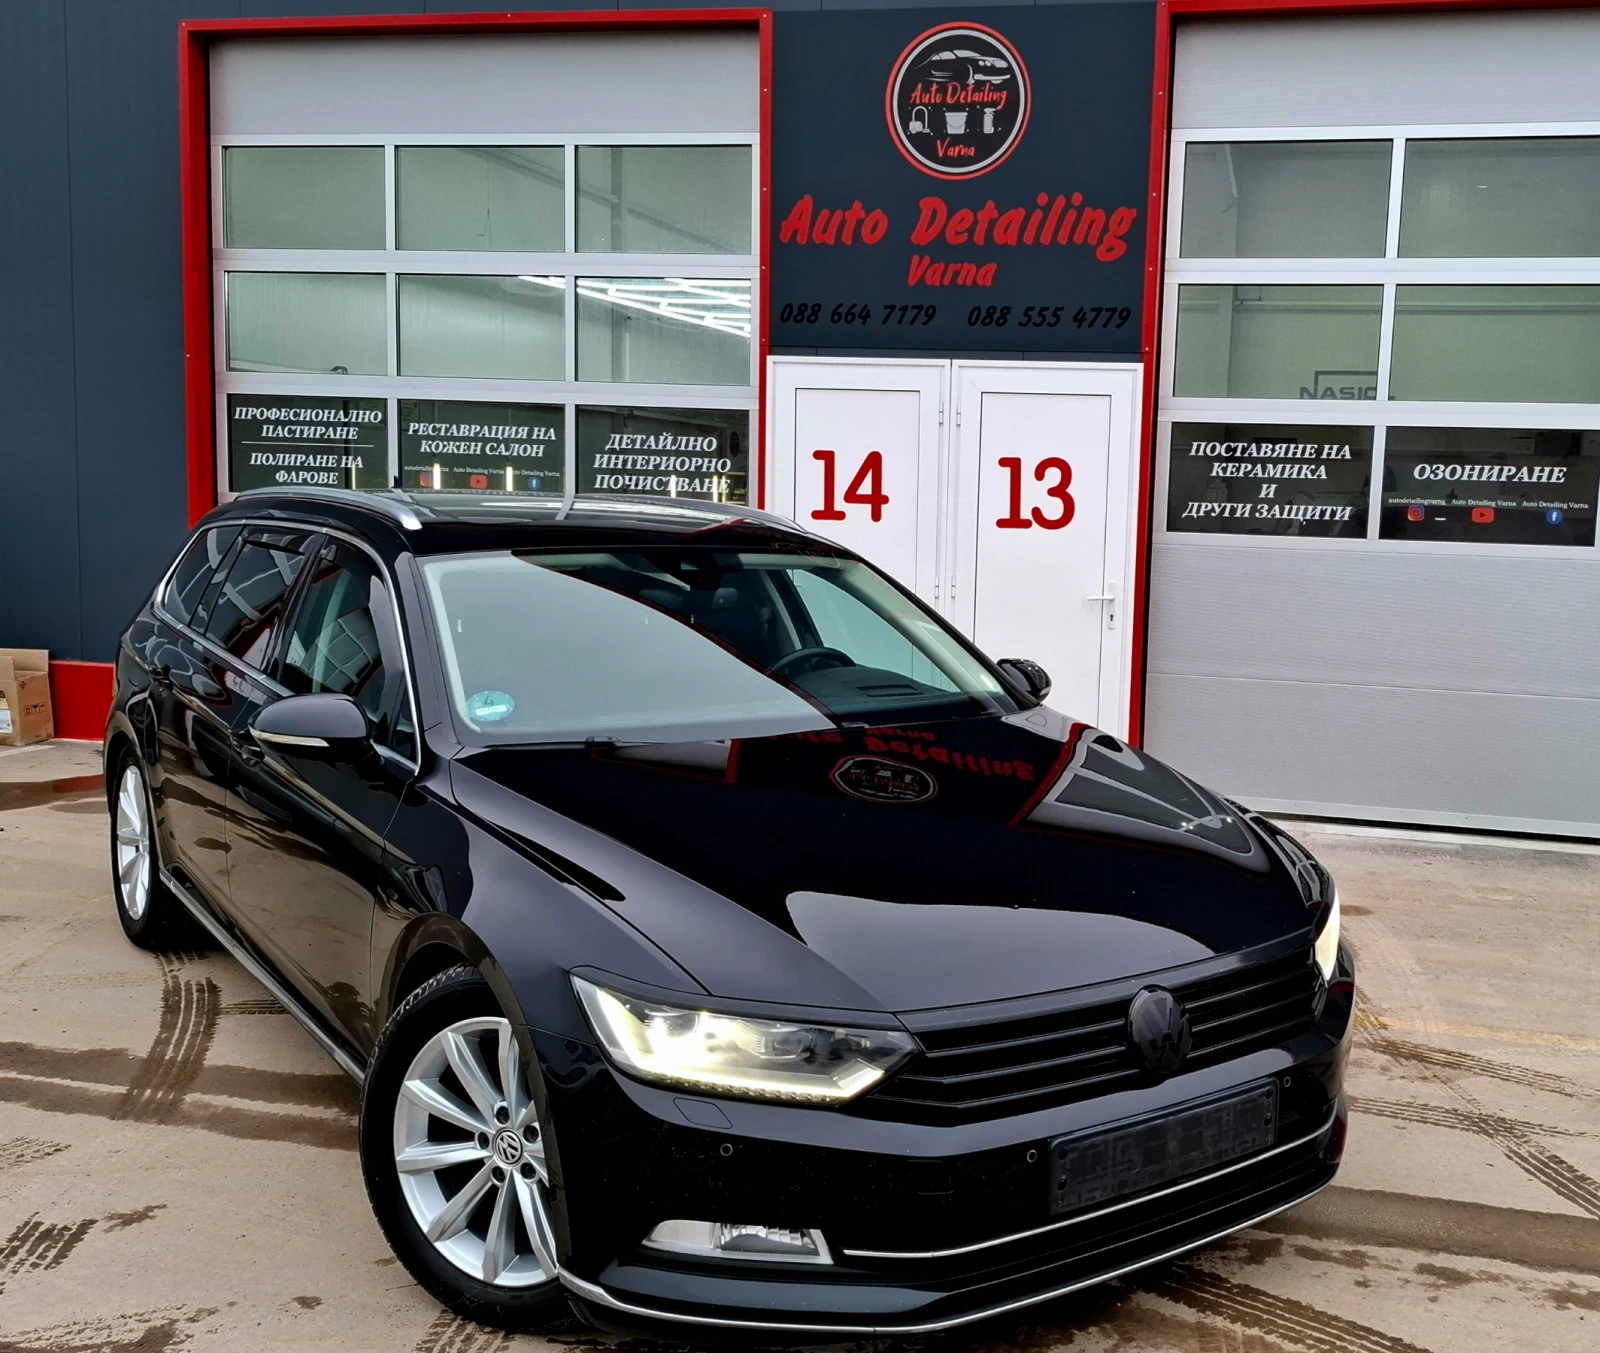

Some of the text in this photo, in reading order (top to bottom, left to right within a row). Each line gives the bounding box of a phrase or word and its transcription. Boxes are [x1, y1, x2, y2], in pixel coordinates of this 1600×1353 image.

[910, 82, 1008, 111] Auto Detailing
[936, 136, 976, 158] Varna
[780, 192, 1137, 262] Auto Detailing
[907, 254, 998, 287] Varna
[780, 302, 1132, 330] 088 664 7179 088 555 4779
[234, 406, 382, 424] ПРОФЕСИОНАЛНО
[260, 424, 359, 440] ПАСТИРАНЕ
[407, 422, 557, 441] РЕСТАВРАЦИЯ НА
[419, 440, 545, 458] КОЖЕН САЛОН
[605, 432, 717, 452] ДЕТАЙЛНО
[1189, 441, 1352, 460] ПОСТАВЯНЕ НА
[249, 452, 364, 469] ПОЛИРАНЕ НА
[593, 453, 731, 474] ИНТЕРИОРНО
[275, 470, 339, 485] ФАРОВЕ
[1210, 462, 1328, 480] КЕРАМИКА
[1413, 463, 1567, 483] ОЗОНИРАНЕ
[811, 450, 890, 522] 14
[996, 457, 1075, 530] 13
[1258, 483, 1278, 499] И
[1182, 502, 1353, 522] ДРУГИ ЗАЩИТИ
[1468, 499, 1496, 507] Detailing
[1539, 501, 1567, 509] Detailing
